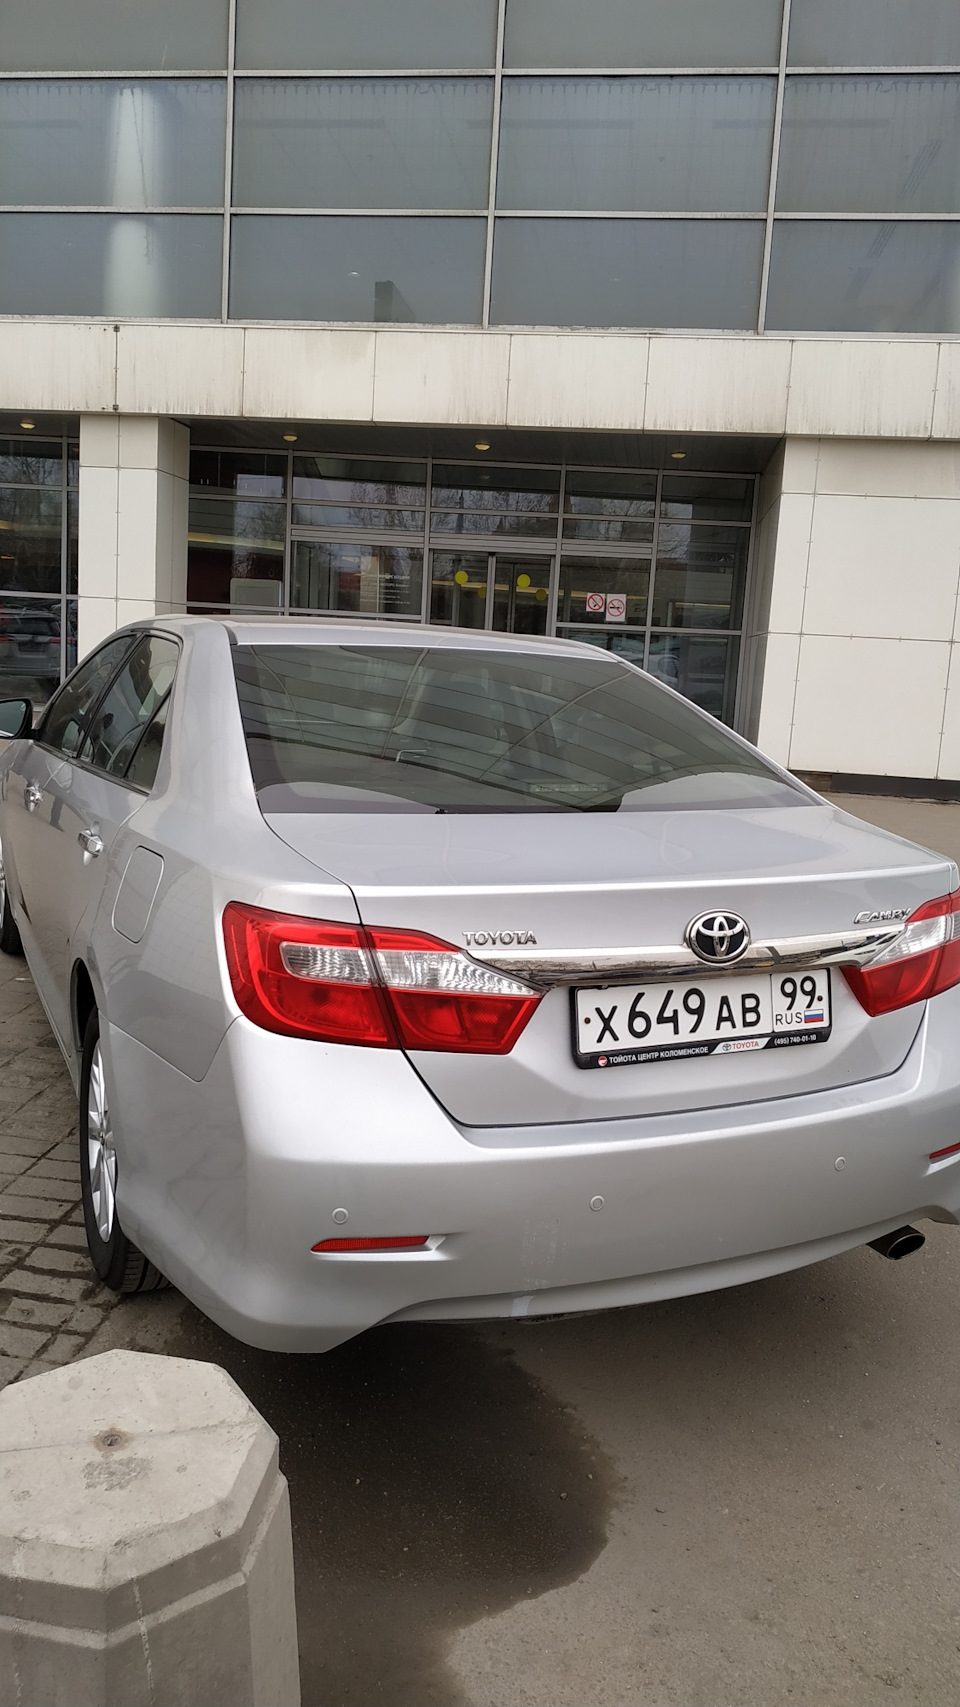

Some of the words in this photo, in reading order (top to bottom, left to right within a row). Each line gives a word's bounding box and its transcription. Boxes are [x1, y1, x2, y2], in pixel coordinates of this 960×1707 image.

[462, 930, 538, 946] TOYOTA
[780, 975, 817, 1011] 99
[775, 1012, 803, 1026] RUS
[732, 1040, 760, 1050] TOYOTA
[774, 1036, 790, 1047] (495)
[790, 1034, 817, 1044] 740-01-10
[609, 1054, 637, 1064] ТОЙОТА
[638, 1051, 660, 1062] ЦЕНТР
[660, 1046, 709, 1059] КОЛОМЕНСКОЕ
